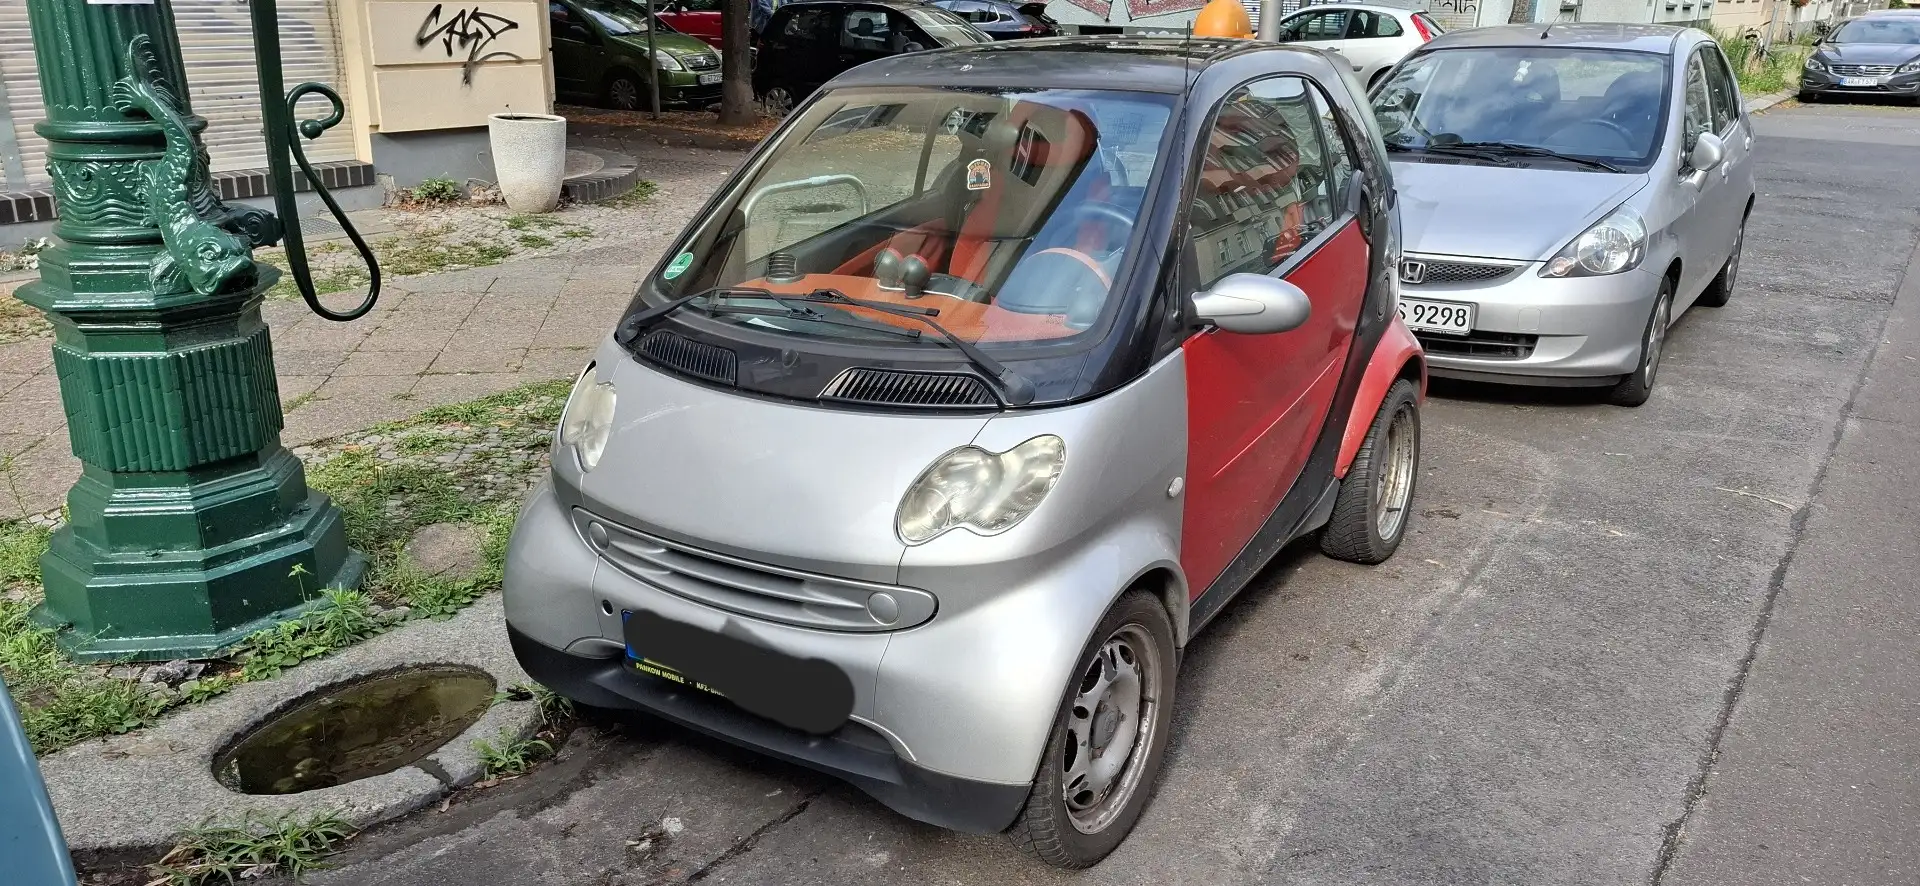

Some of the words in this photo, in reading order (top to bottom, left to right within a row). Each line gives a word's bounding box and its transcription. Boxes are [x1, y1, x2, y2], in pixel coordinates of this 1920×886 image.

[1413, 304, 1467, 327] 9298
[636, 662, 661, 676] PANKOW
[662, 671, 684, 684] MOBILE
